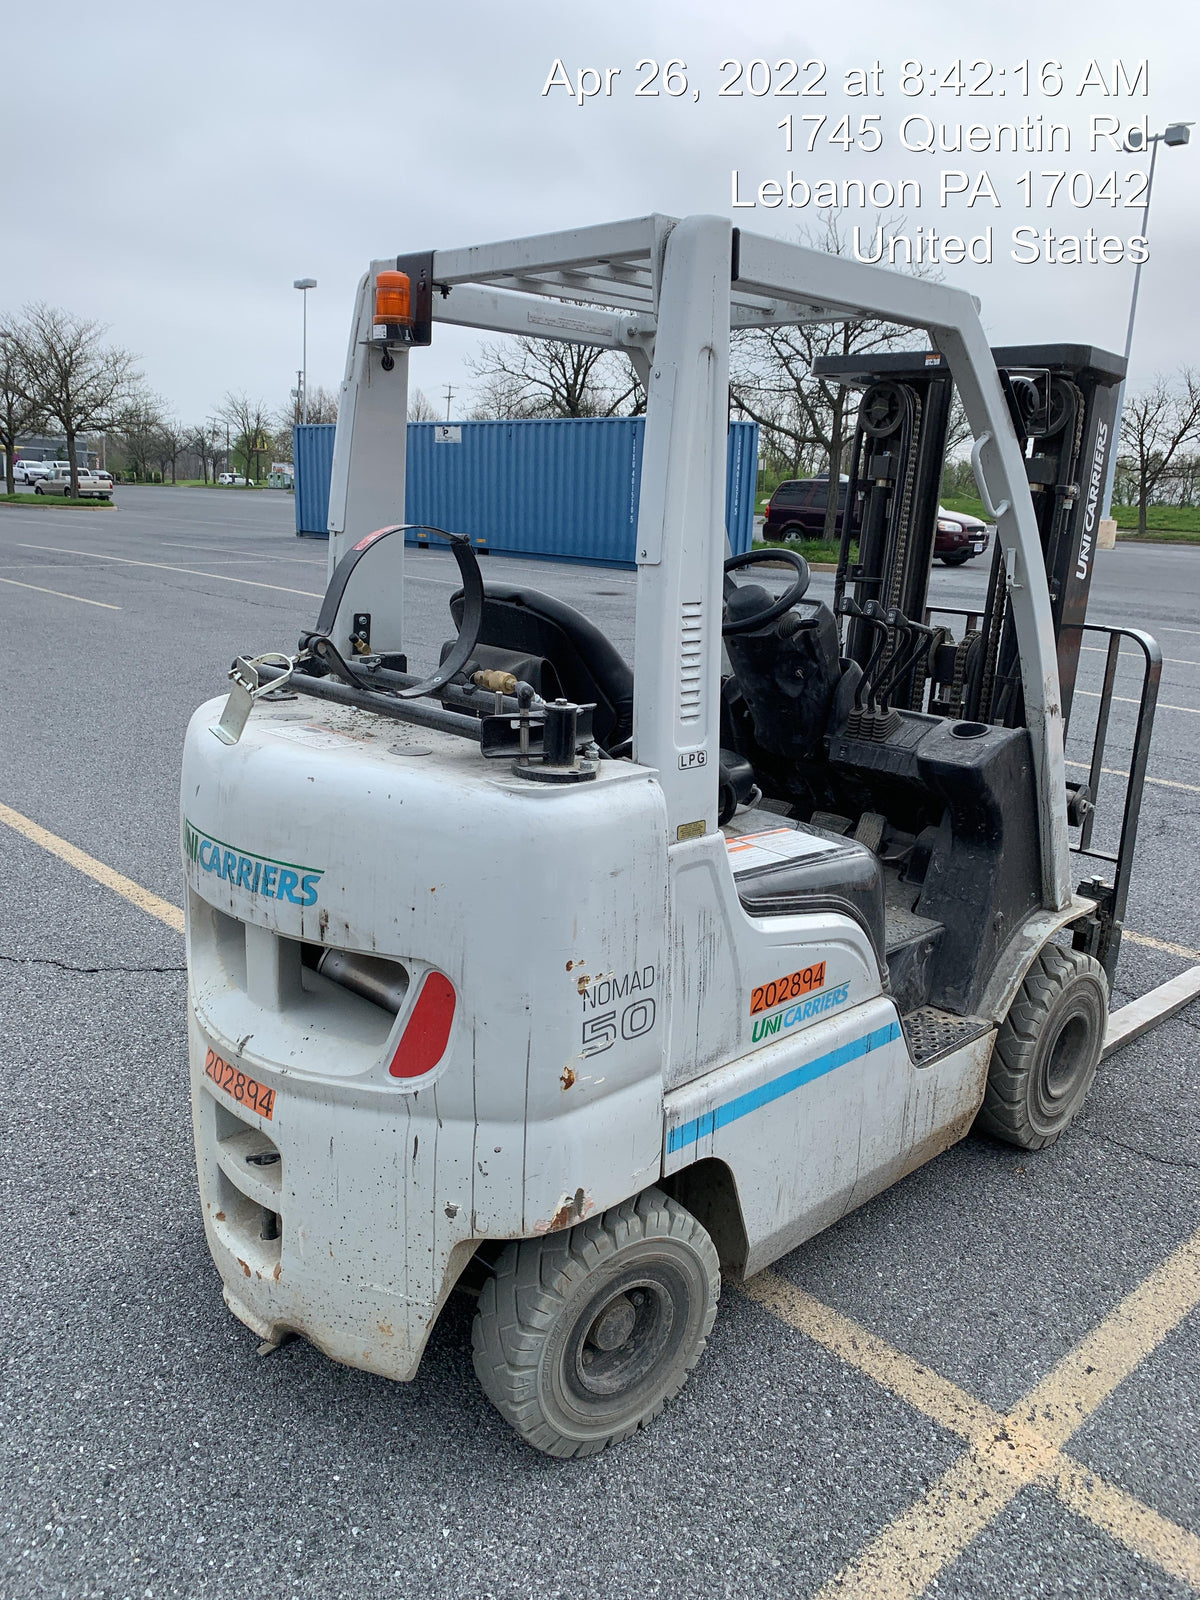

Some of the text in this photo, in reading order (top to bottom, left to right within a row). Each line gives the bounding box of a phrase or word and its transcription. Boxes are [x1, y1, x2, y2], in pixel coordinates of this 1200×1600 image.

[681, 752, 705, 767] LPG
[583, 965, 655, 1012] NOMAD
[751, 962, 824, 1014] 202894
[582, 997, 656, 1059] 50
[205, 1048, 273, 1117] 202894
